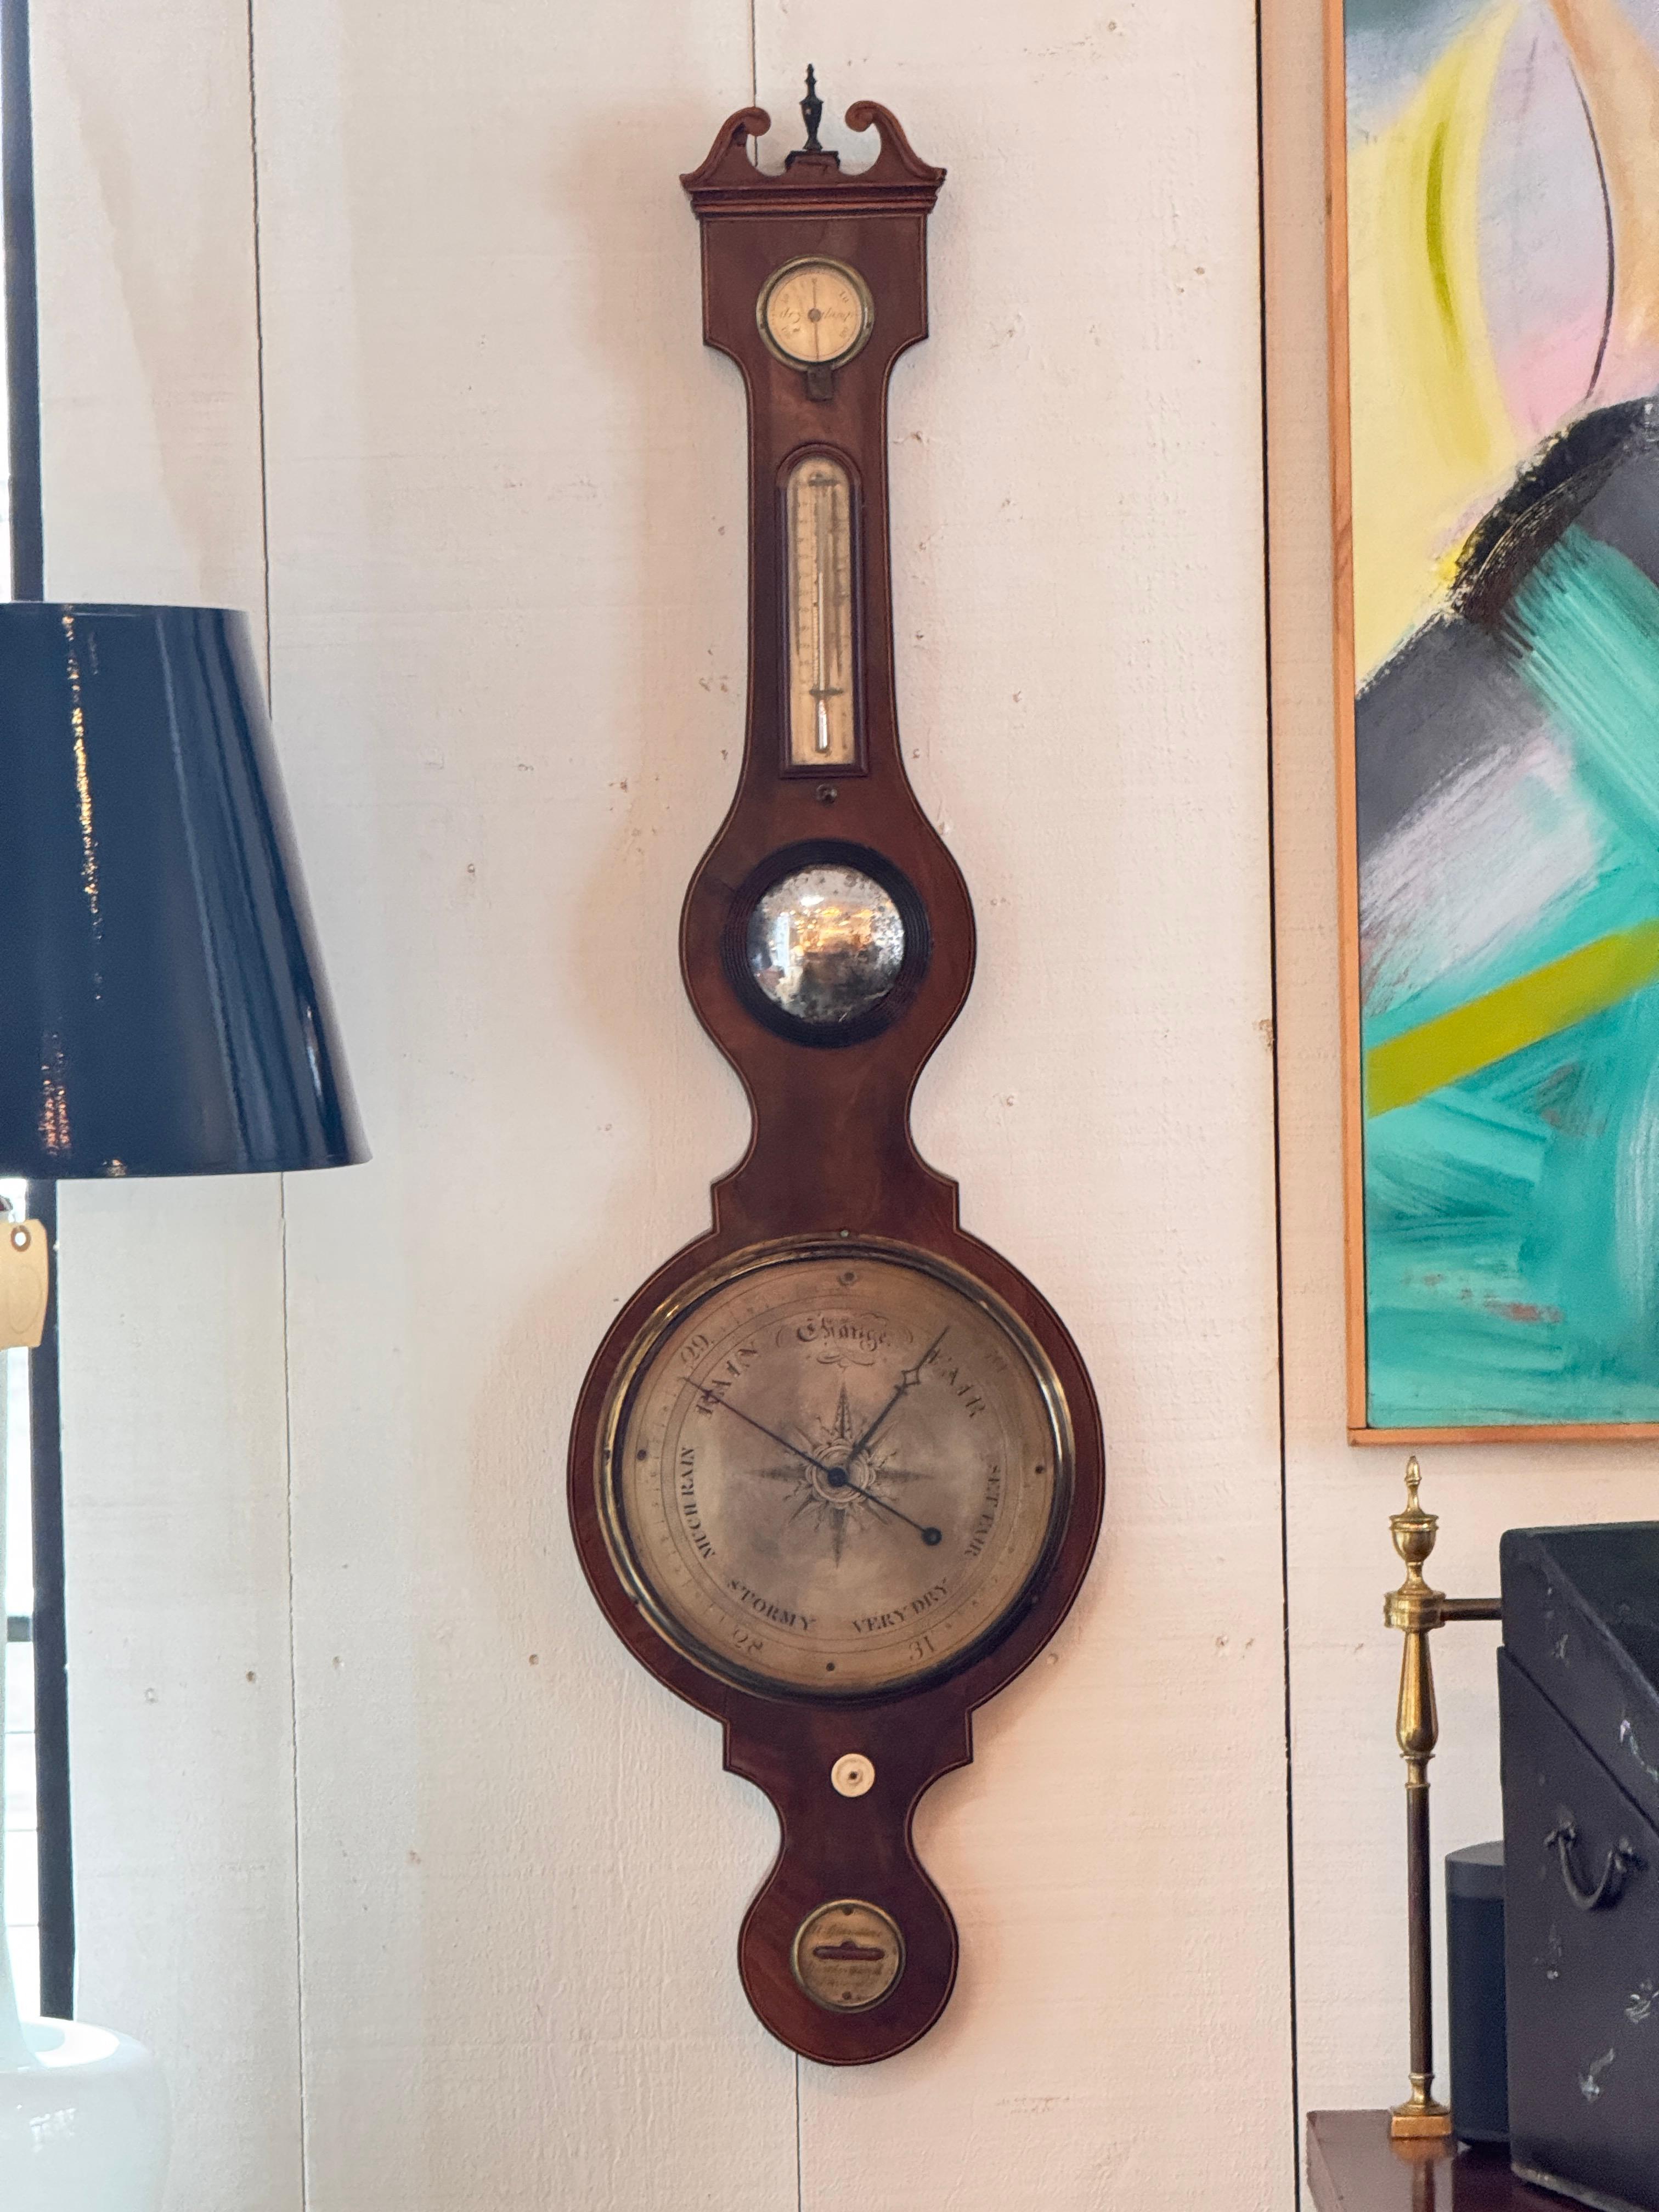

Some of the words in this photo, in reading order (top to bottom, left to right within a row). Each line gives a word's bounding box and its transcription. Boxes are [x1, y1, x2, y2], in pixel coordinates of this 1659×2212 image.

[780, 307, 802, 323] dry
[696, 1339, 759, 1417] RAIN
[679, 1447, 695, 1496] RAIN
[985, 1464, 1001, 1508] SET
[683, 1503, 716, 1560] MUCH
[726, 1578, 817, 1632] STORMY
[851, 1605, 908, 1633] VERY
[909, 1576, 950, 1615] DRY
